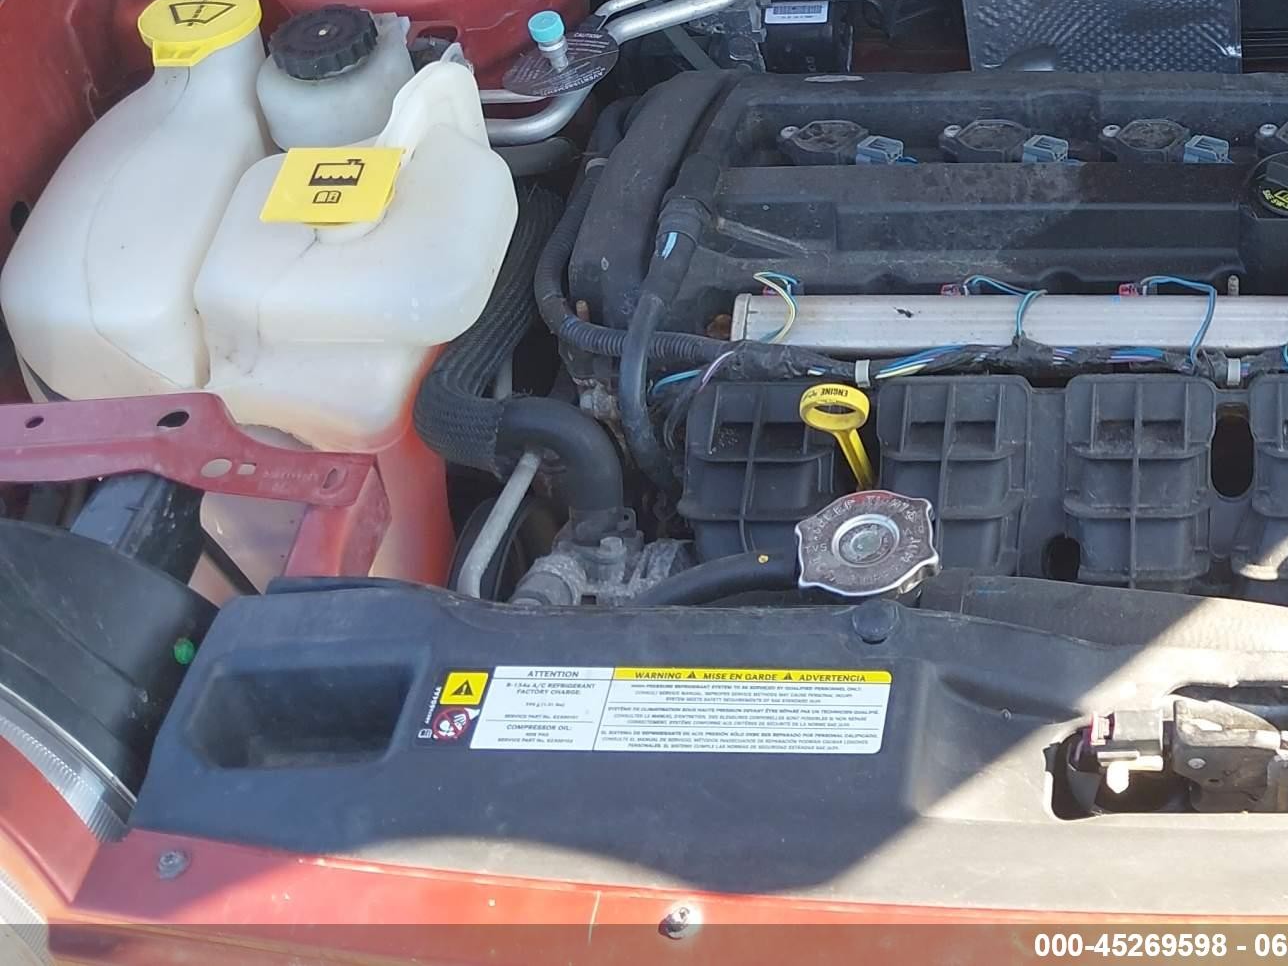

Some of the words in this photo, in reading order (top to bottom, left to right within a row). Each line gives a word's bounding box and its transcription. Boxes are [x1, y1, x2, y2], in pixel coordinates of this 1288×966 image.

[821, 387, 849, 397] ENGINE
[527, 670, 579, 678] ATTENTION
[745, 673, 778, 681] GARDE
[798, 674, 866, 682] ADVERTENCIA
